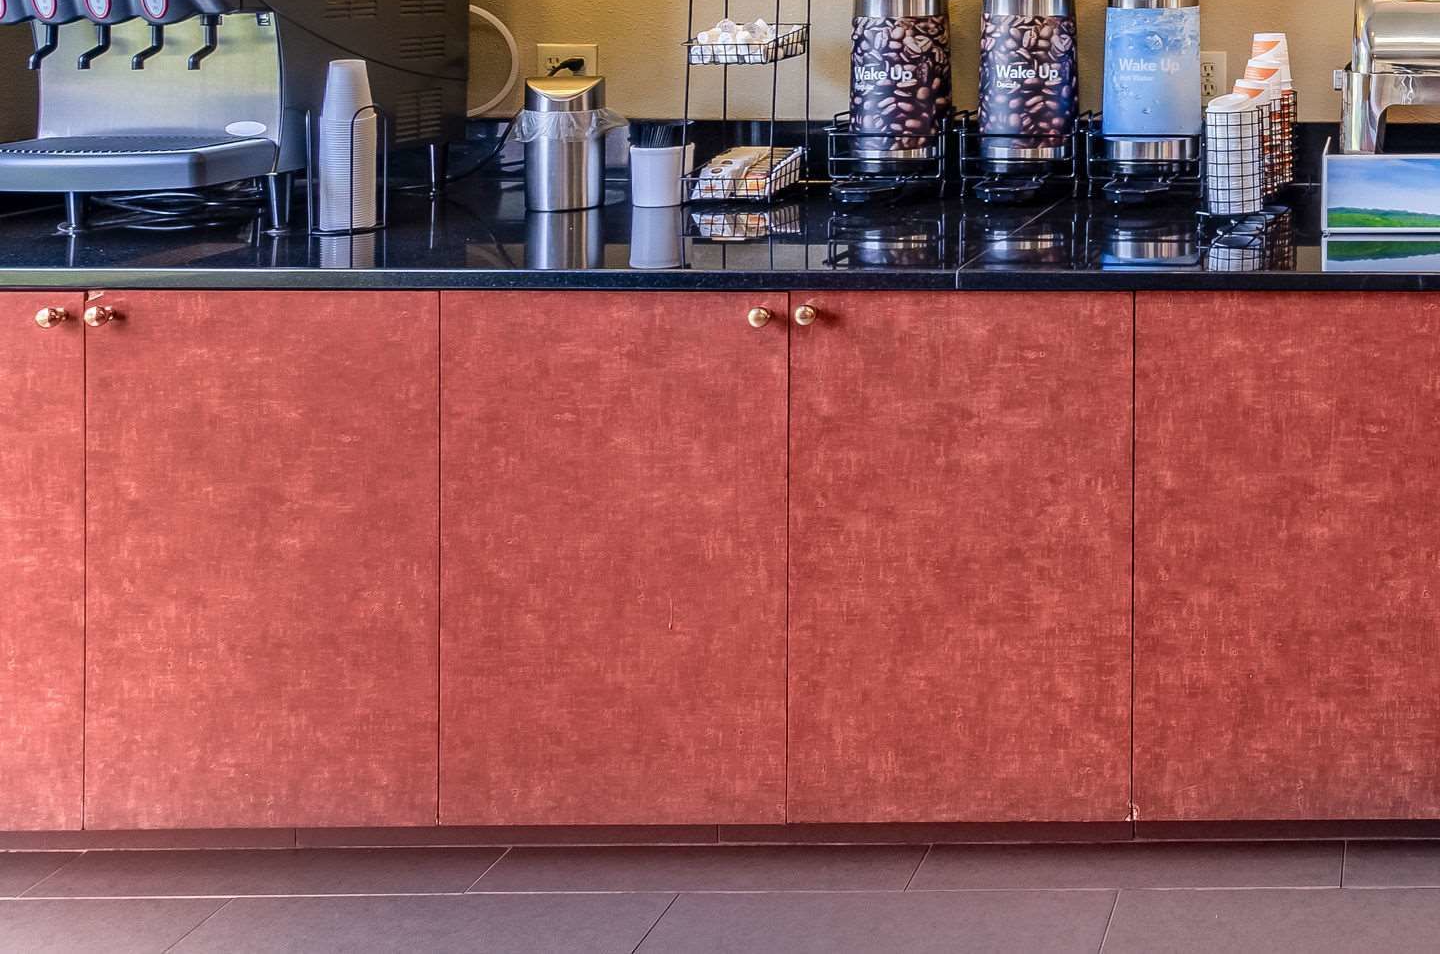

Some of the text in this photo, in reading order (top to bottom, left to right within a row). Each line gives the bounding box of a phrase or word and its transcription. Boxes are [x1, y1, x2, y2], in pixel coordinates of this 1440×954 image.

[854, 66, 913, 82] Wake Up
[996, 64, 1059, 81] Wake Up
[1119, 58, 1180, 74] Wake Up
